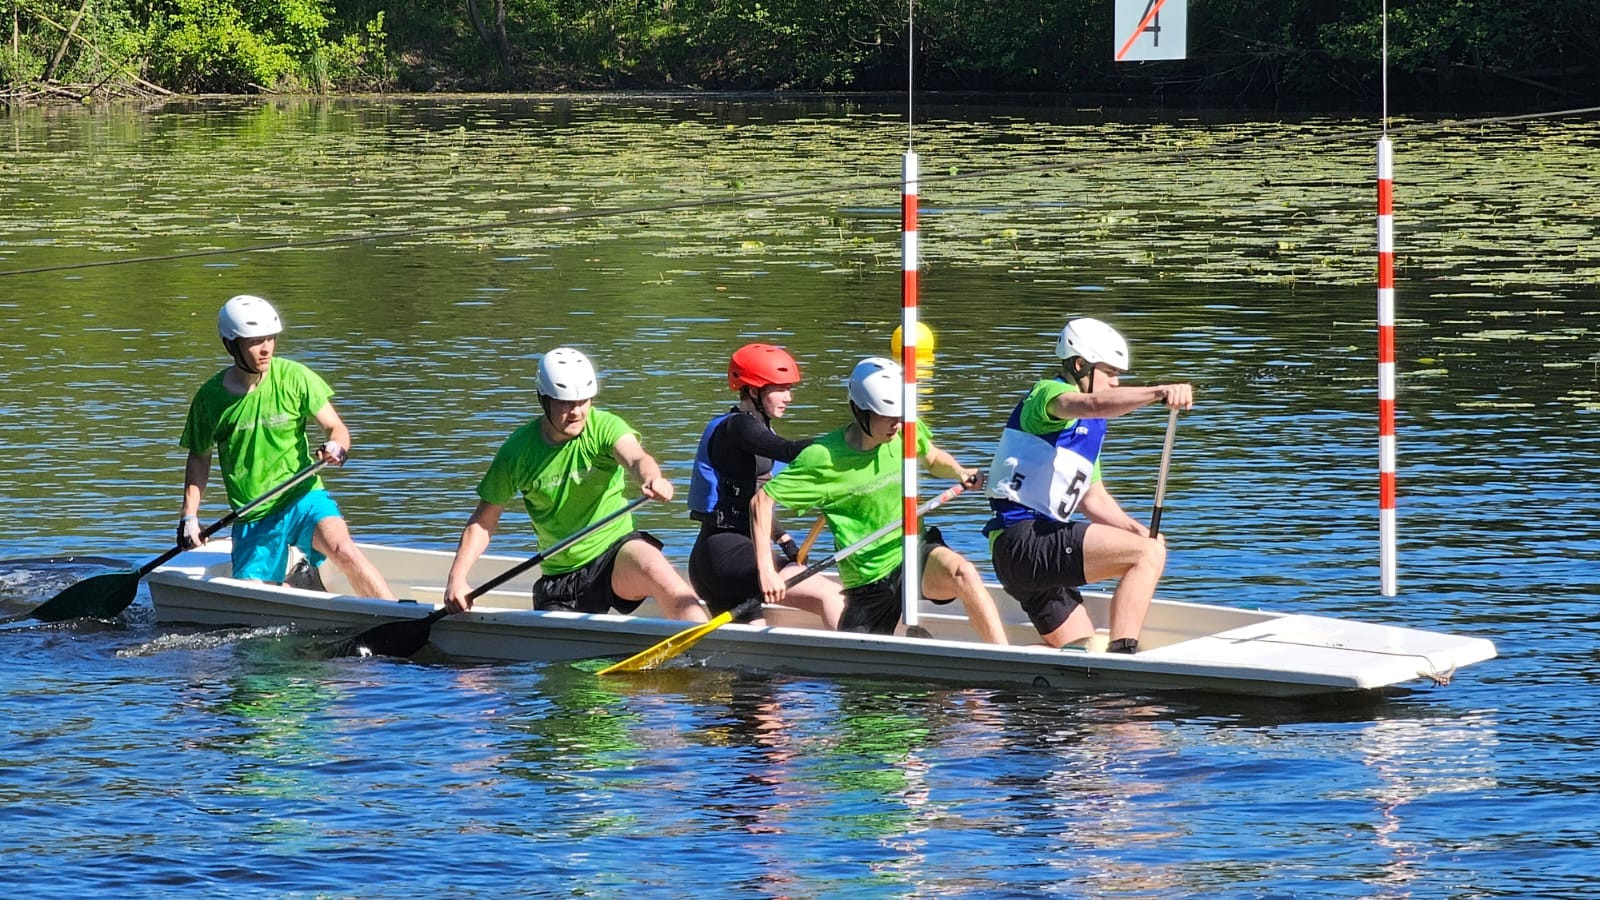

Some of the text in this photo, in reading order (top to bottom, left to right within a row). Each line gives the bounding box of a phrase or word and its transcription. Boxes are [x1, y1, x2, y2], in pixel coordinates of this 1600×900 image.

[1138, 0, 1161, 47] 4
[1010, 472, 1025, 491] 5
[1058, 470, 1087, 518] 5
